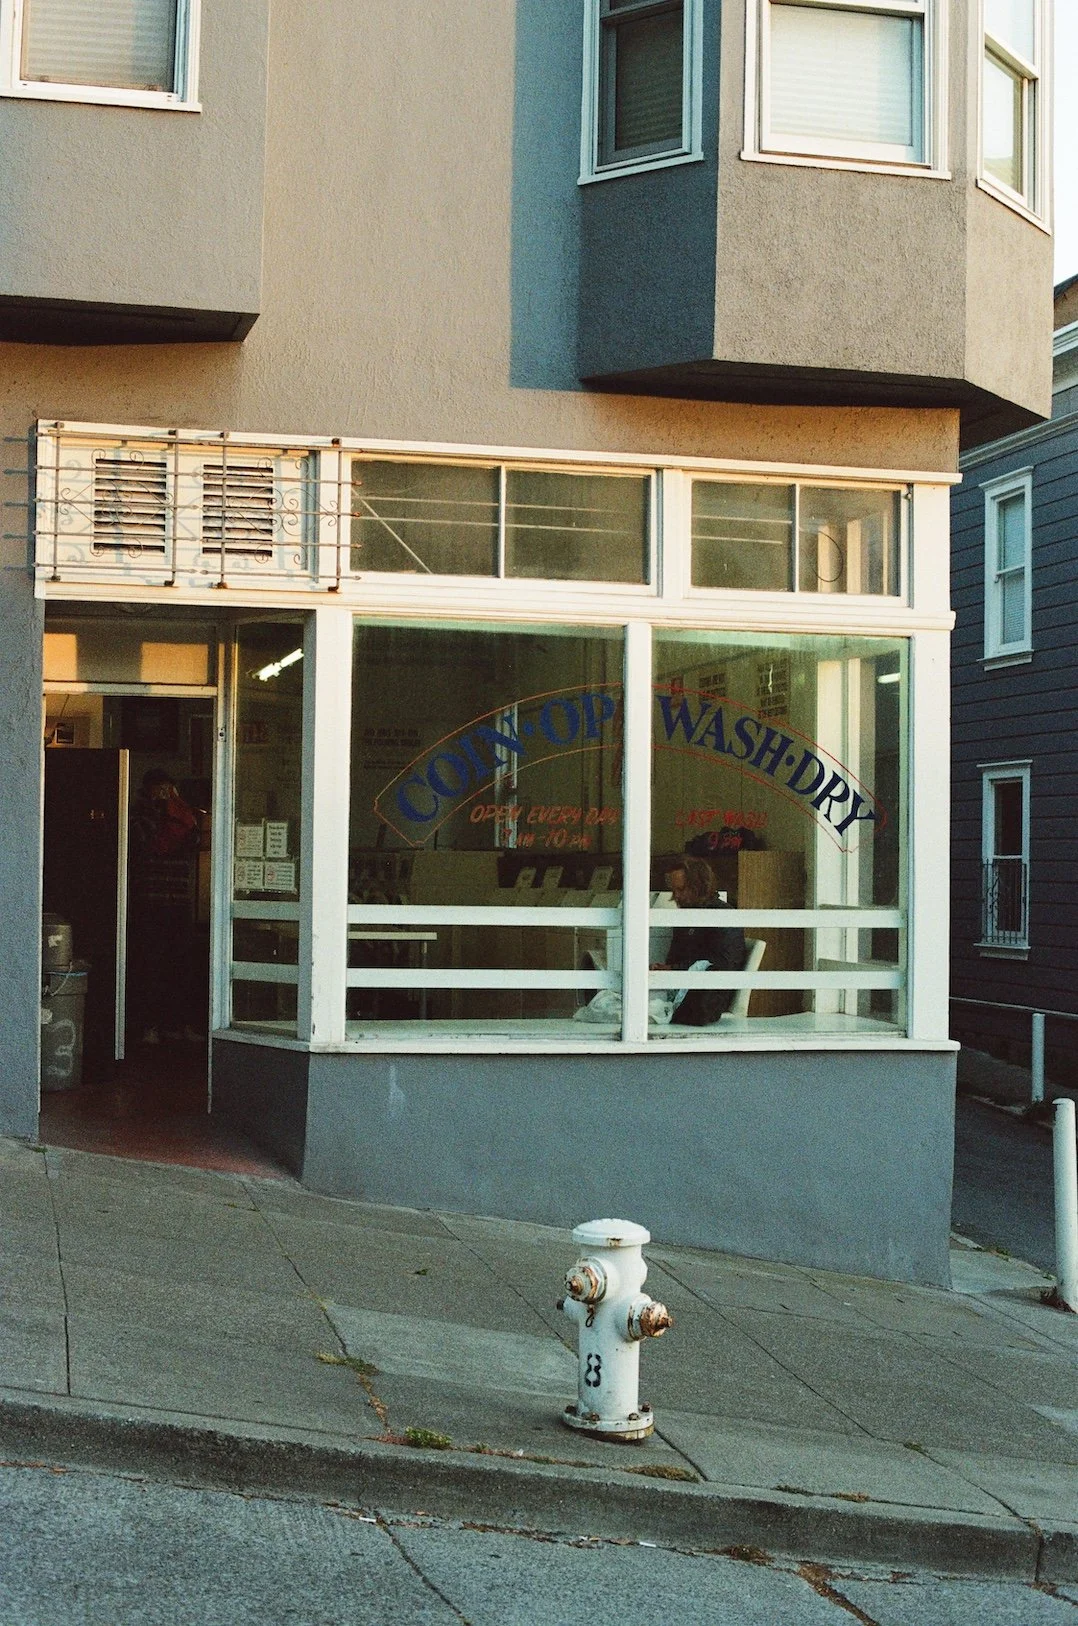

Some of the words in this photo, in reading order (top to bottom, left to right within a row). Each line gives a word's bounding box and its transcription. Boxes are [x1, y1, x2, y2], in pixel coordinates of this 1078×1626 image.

[470, 804, 522, 824] OPEN
[527, 805, 582, 825] EVERY
[585, 807, 620, 825] DAY
[675, 809, 720, 827] LAST
[723, 810, 768, 828] WASH
[584, 1353, 602, 1388] 8
